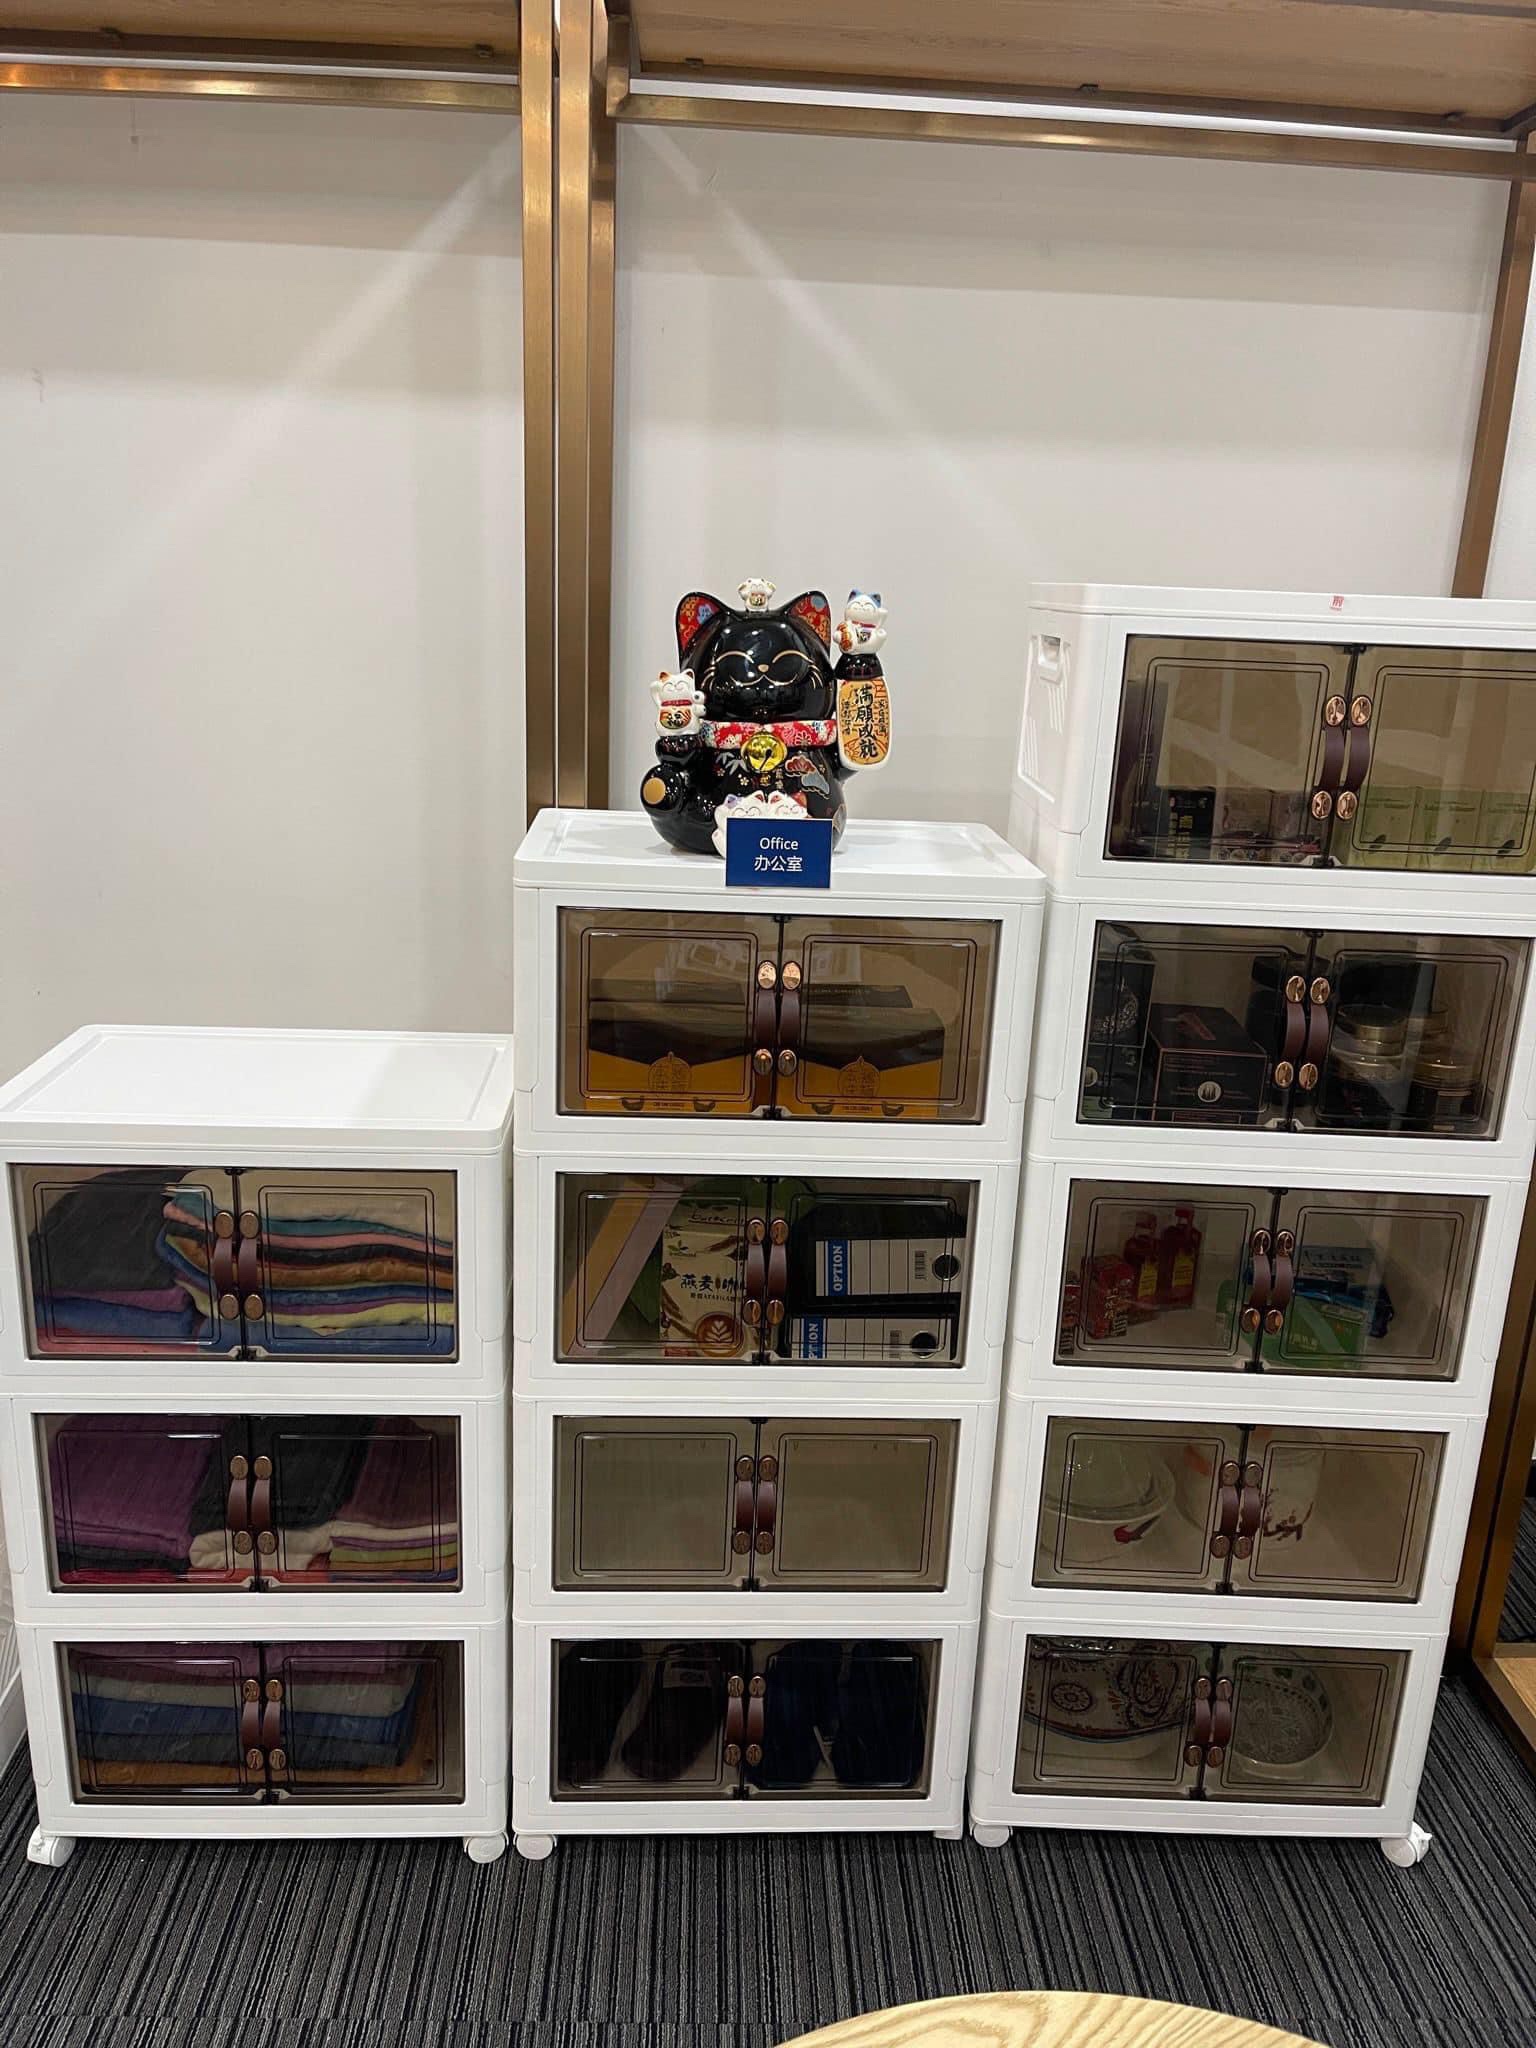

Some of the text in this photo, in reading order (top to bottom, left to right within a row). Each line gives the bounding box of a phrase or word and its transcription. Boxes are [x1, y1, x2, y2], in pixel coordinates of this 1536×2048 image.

[759, 836, 799, 850] Office
[754, 855, 803, 872] 办公室
[833, 1245, 843, 1292] OPTION
